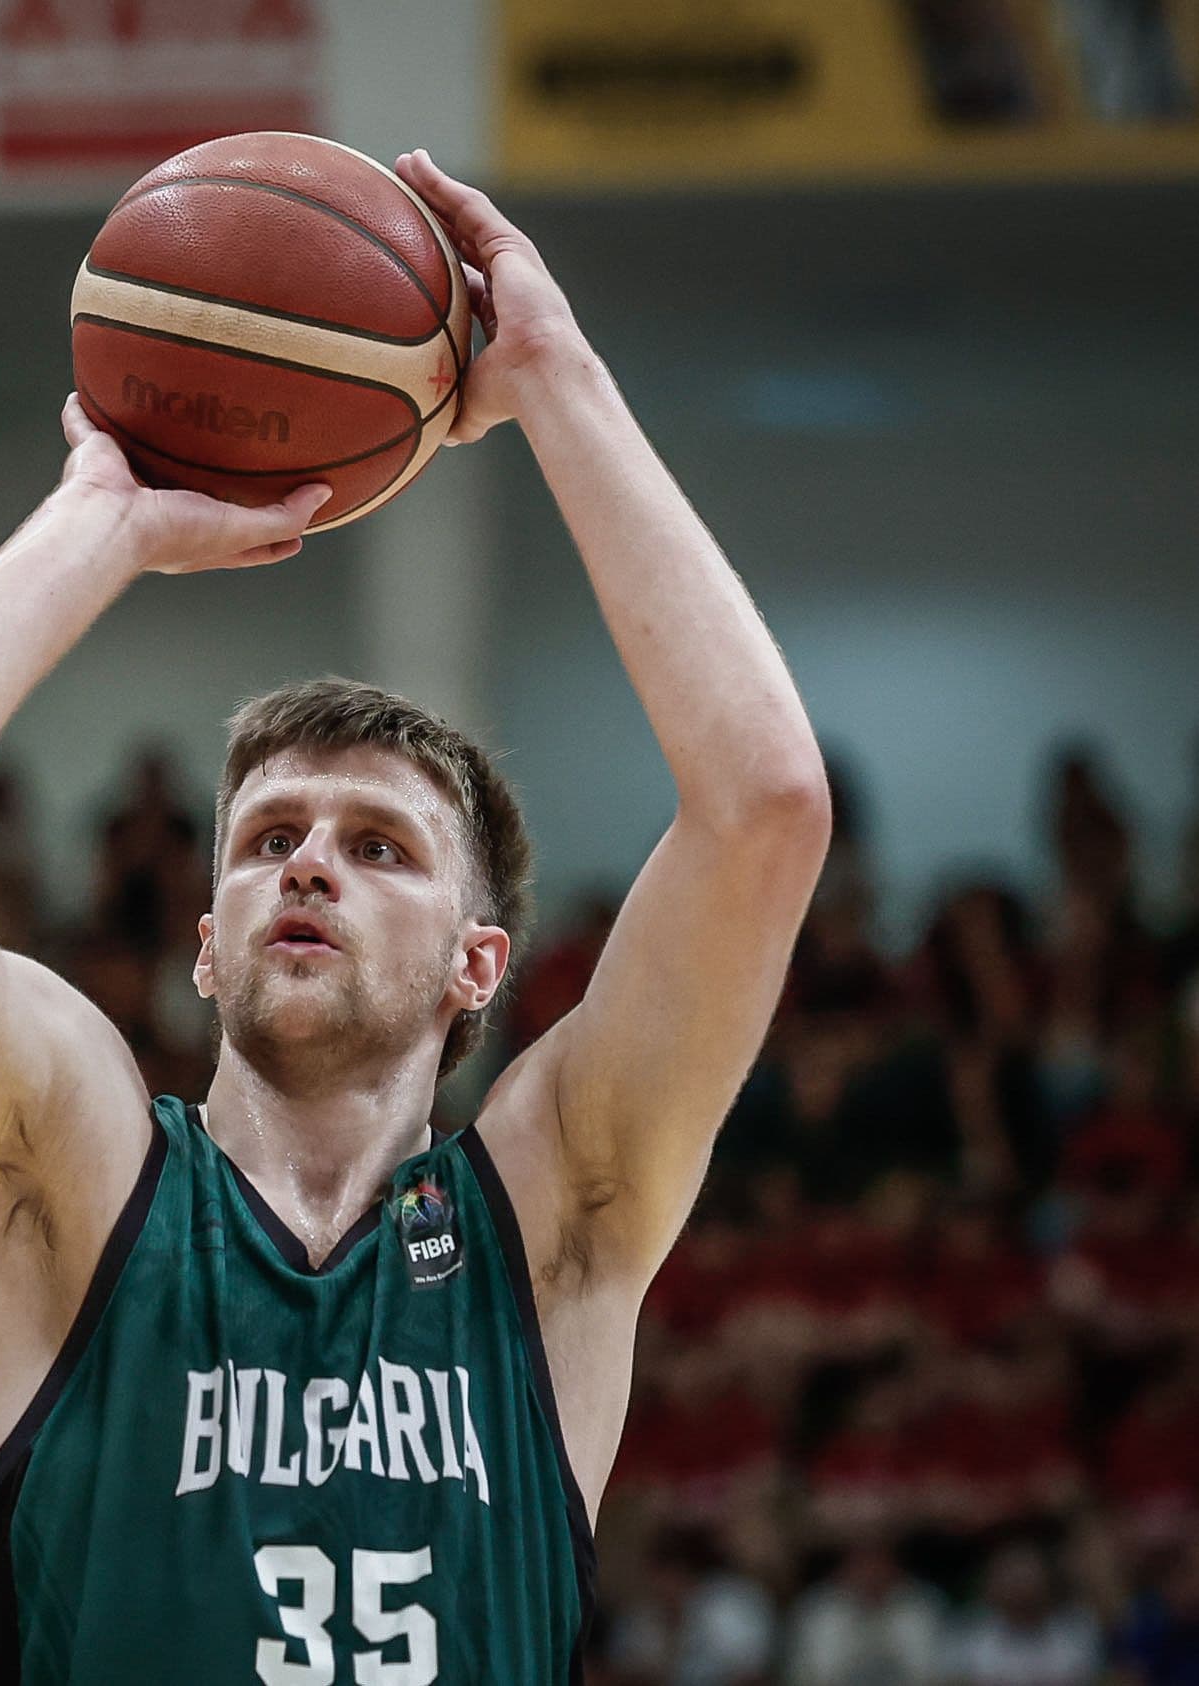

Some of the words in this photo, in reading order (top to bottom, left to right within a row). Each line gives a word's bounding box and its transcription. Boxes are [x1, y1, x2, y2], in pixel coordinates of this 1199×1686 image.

[122, 374, 290, 442] molten
[408, 1234, 456, 1262] FIBA
[175, 1355, 489, 1506] BULGARIA
[253, 1545, 437, 1686] 35
